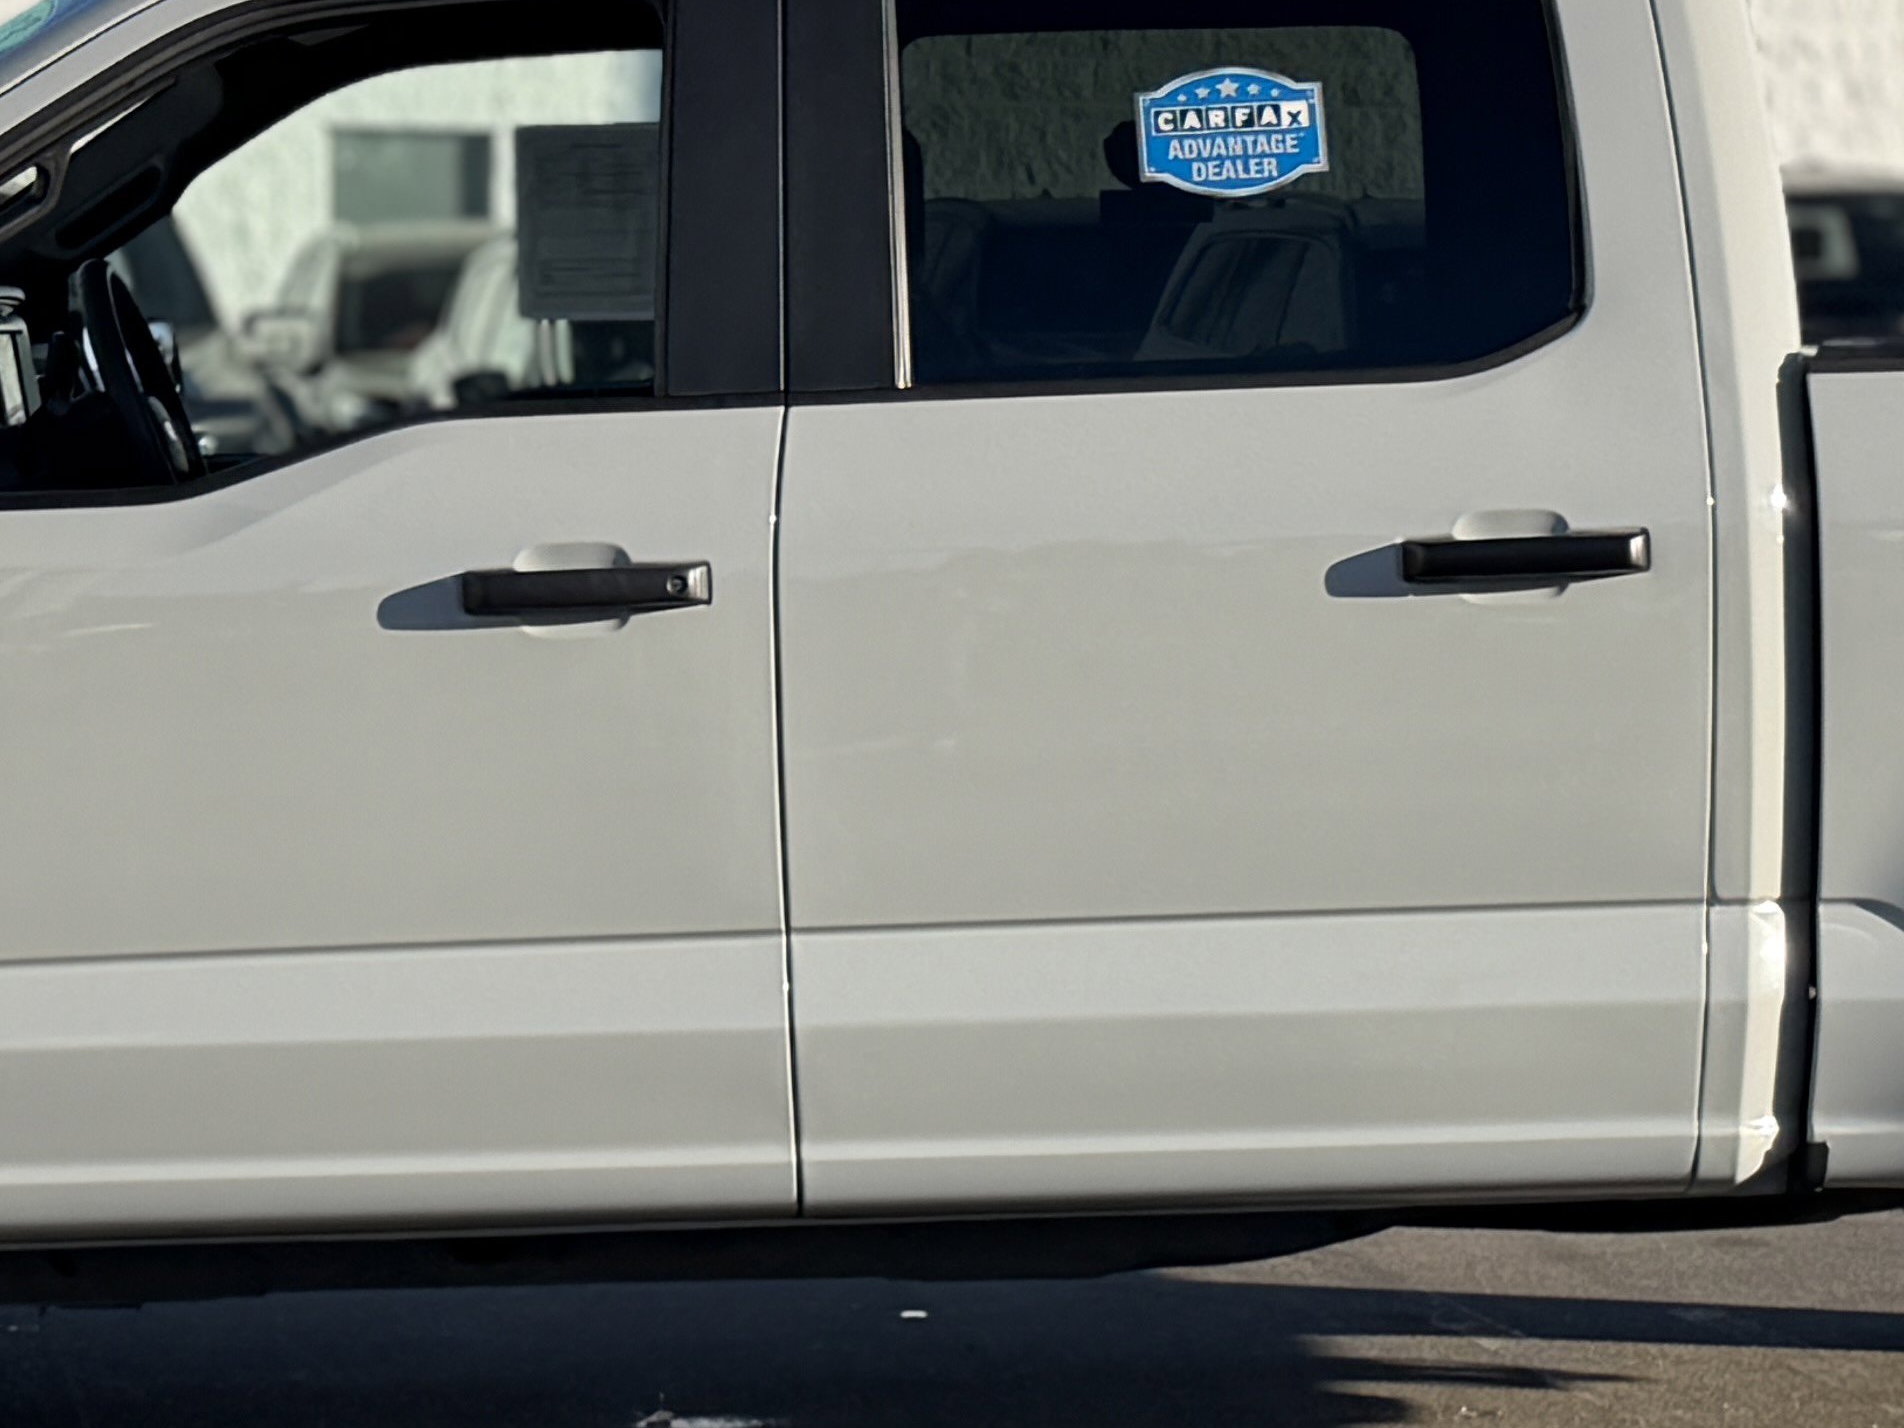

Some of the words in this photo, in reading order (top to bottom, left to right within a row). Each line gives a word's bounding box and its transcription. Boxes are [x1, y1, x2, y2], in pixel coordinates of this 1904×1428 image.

[1155, 103, 1305, 132] CARFAX
[1168, 134, 1300, 160] ADVANTAGE
[1191, 158, 1278, 182] DEALER
